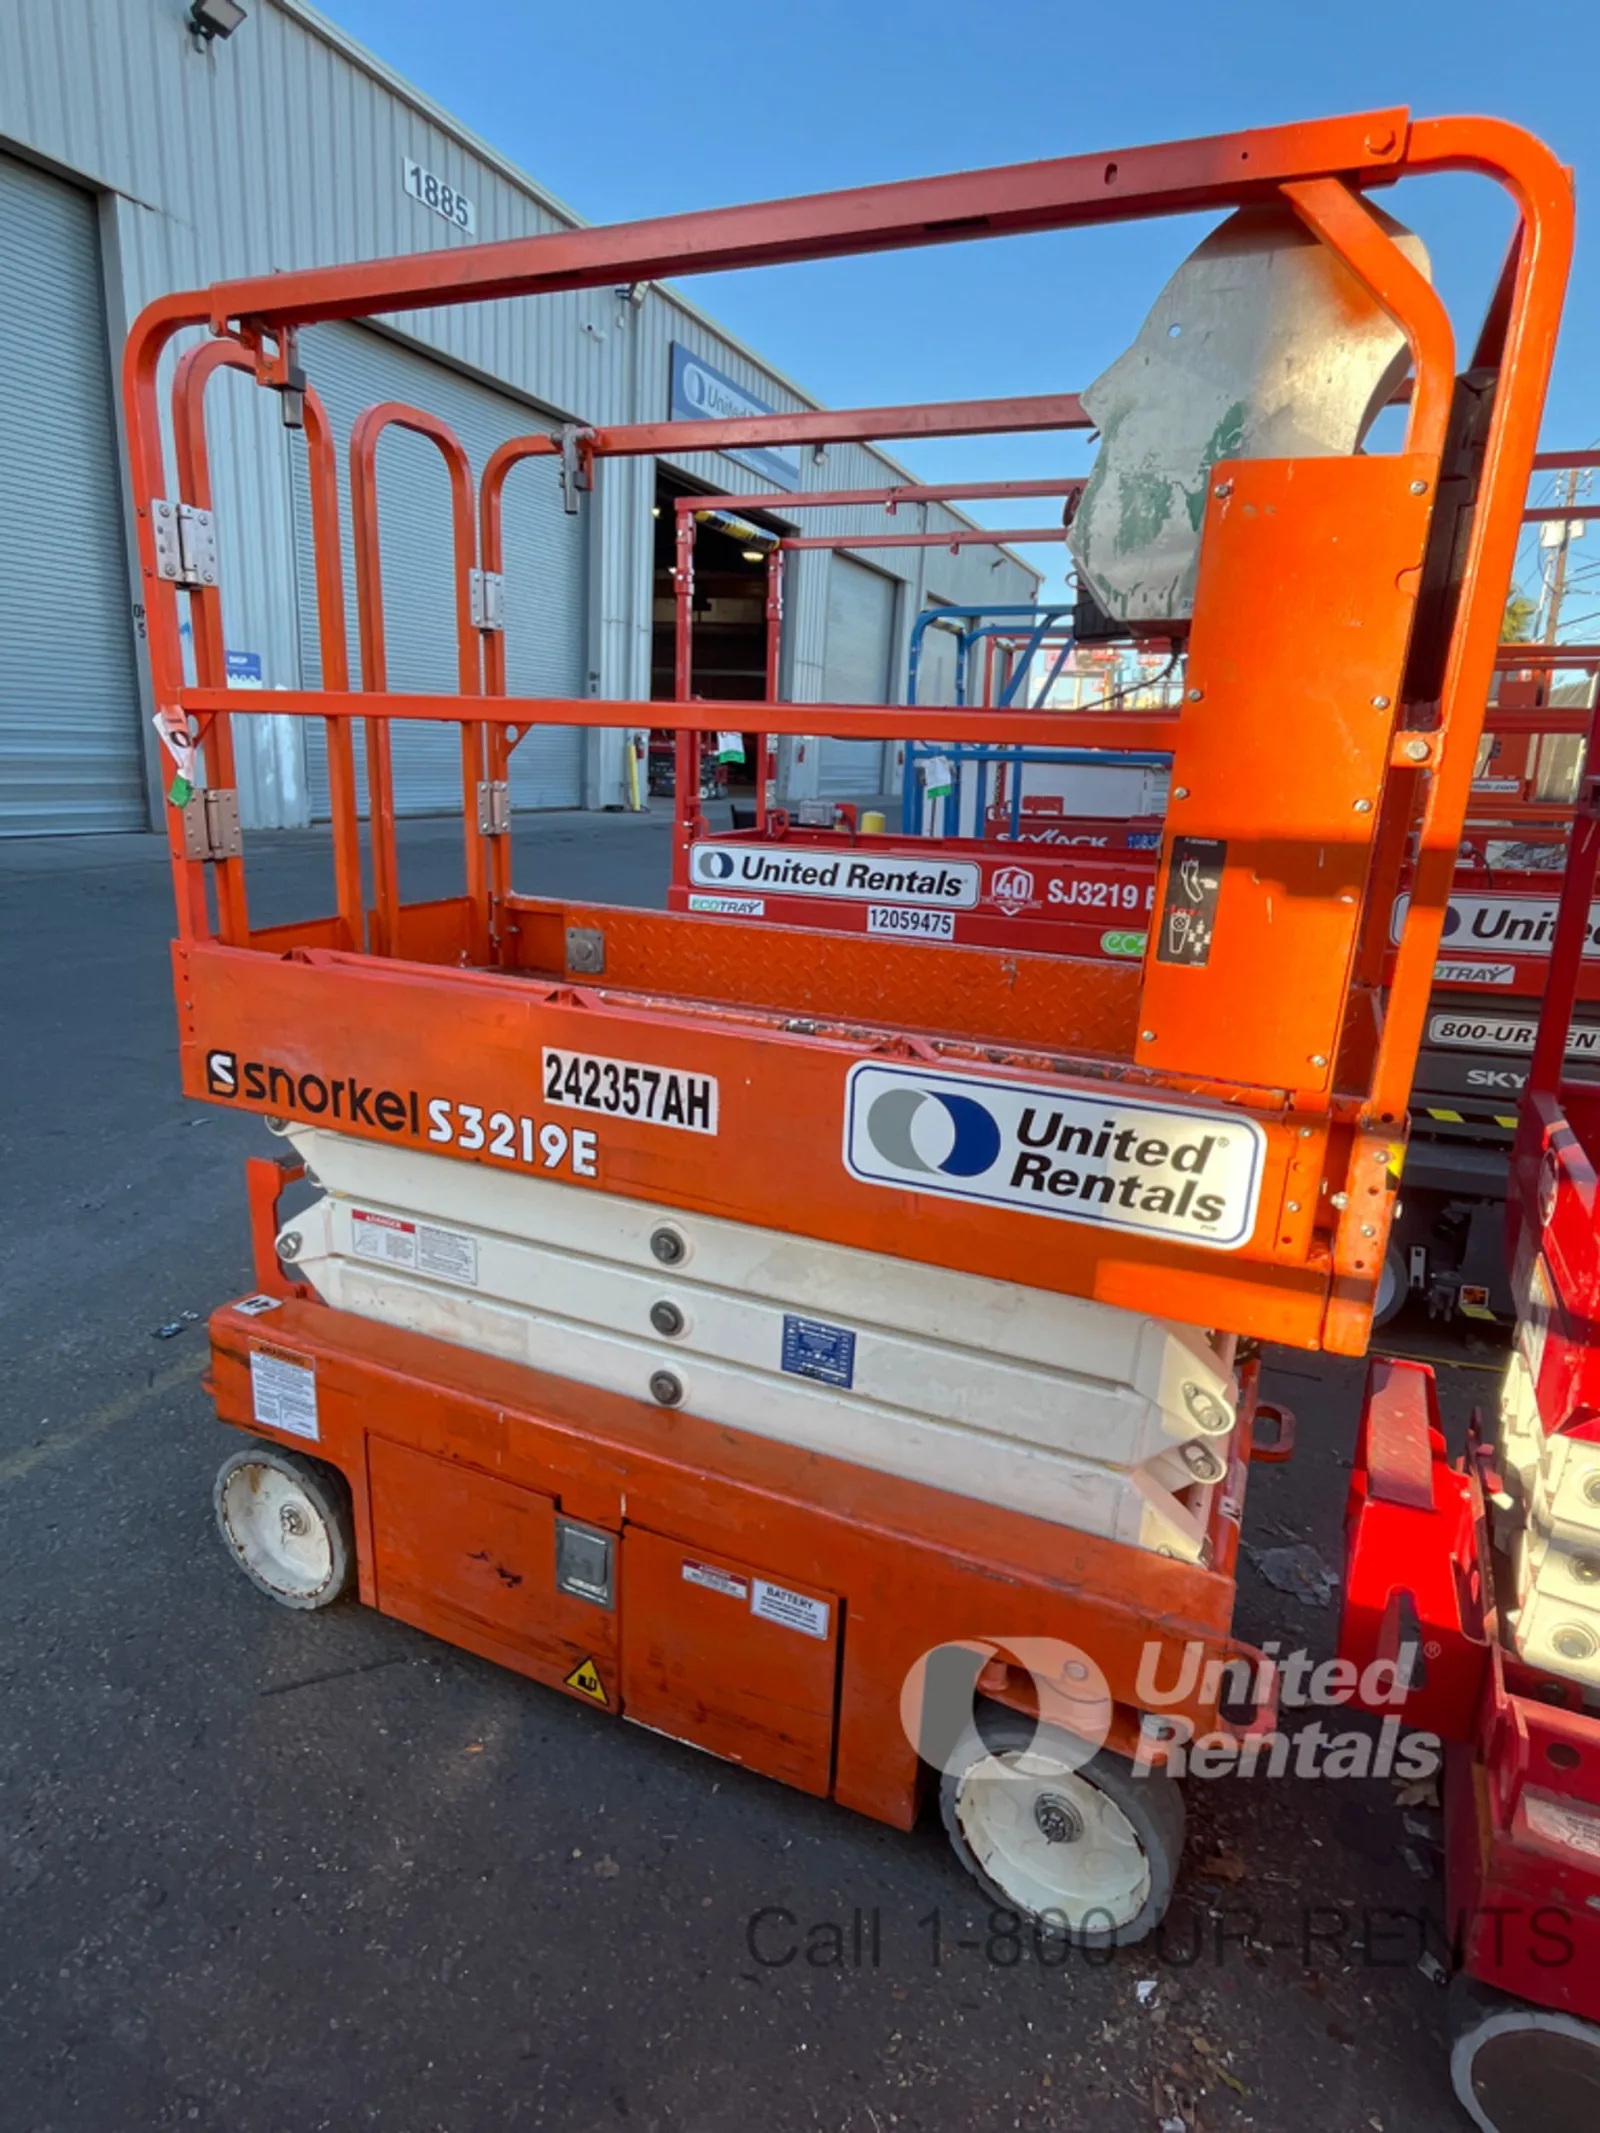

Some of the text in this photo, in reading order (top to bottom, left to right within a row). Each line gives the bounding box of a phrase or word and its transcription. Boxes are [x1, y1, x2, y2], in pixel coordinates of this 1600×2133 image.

[410, 166, 468, 227] 1885
[741, 855, 963, 898] United Rentals
[996, 872, 1028, 899] 40
[1047, 878, 1139, 909] SJ3219
[692, 899, 762, 914] ECOTRAY
[870, 908, 952, 935] 12059475
[545, 1053, 711, 1130] 242357AH
[245, 1061, 420, 1136] snorkel
[428, 1099, 600, 1178] S3219E
[1017, 1107, 1218, 1176] United
[1009, 1152, 1227, 1224] Rentals
